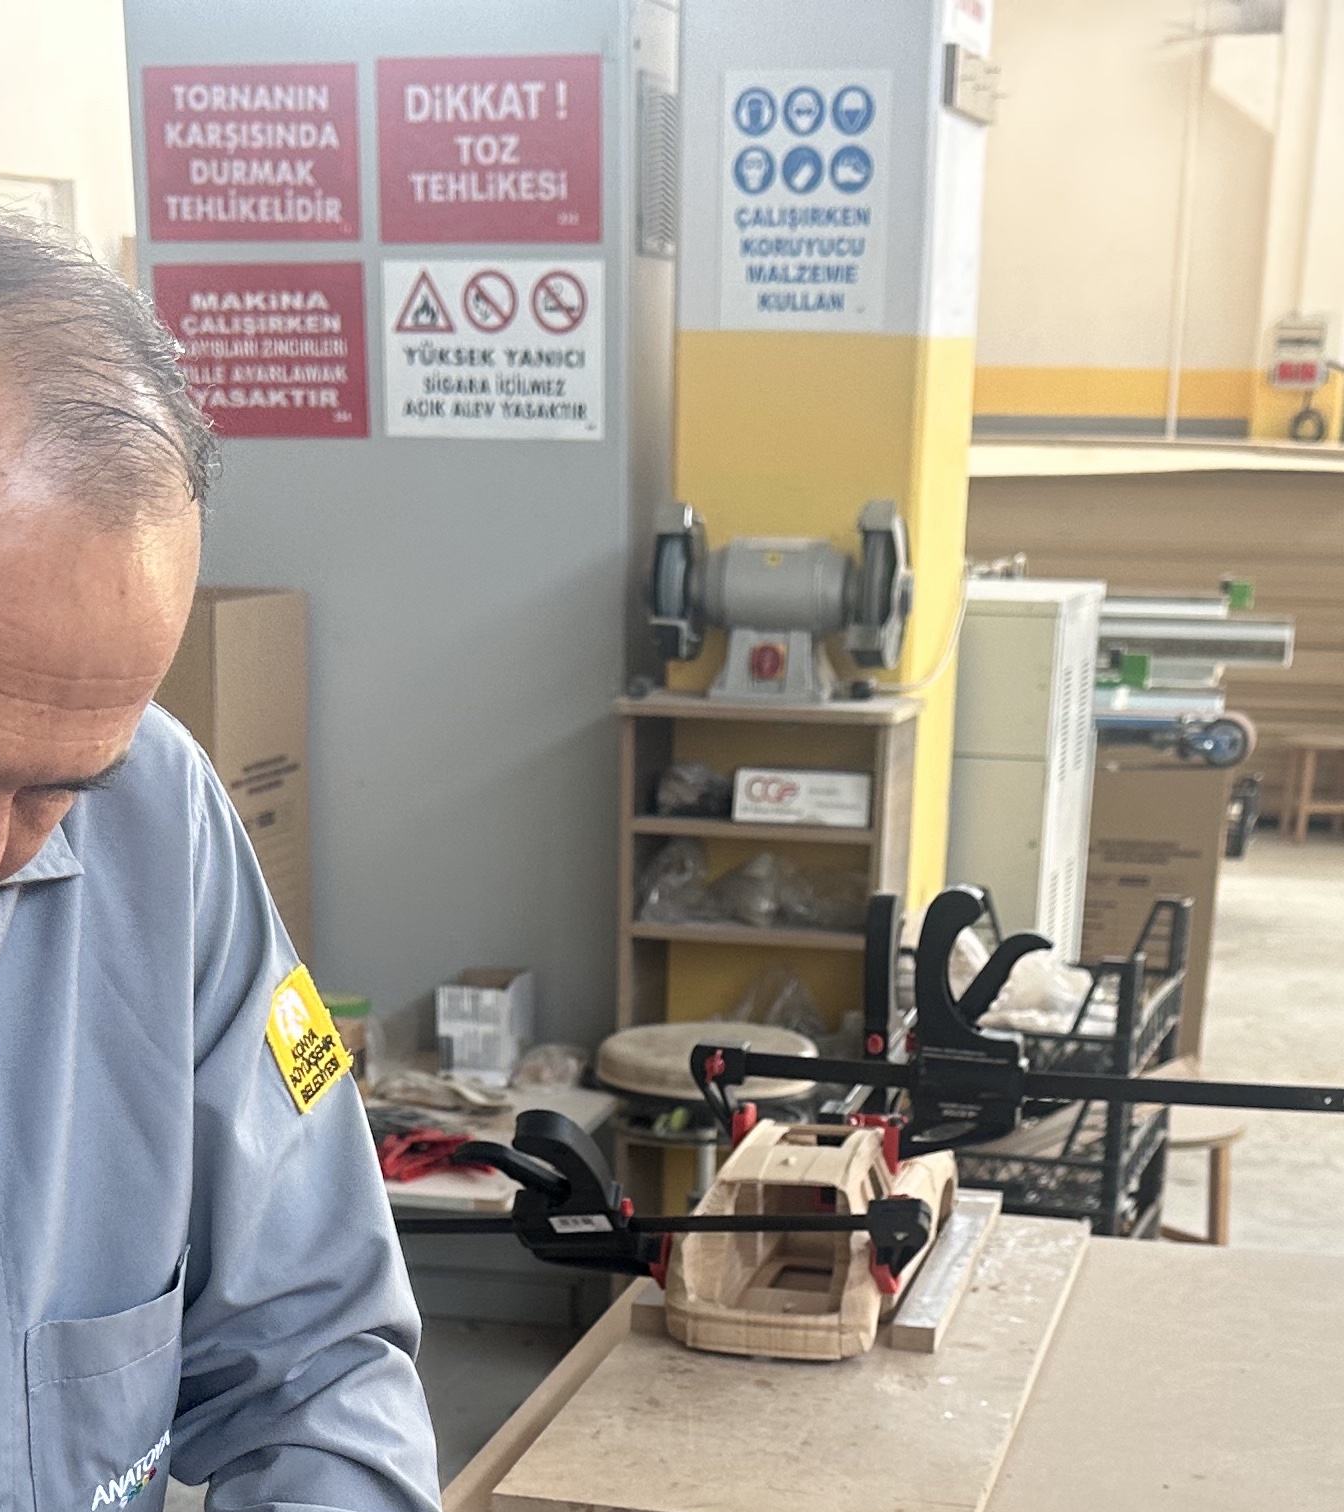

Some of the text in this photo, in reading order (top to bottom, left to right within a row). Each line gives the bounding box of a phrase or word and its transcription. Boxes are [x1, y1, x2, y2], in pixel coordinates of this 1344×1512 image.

[172, 83, 330, 112] TORNANIN
[164, 121, 341, 154] KARŞISINDA
[454, 133, 520, 166] TOZ
[189, 158, 316, 187] DURMAK
[165, 188, 344, 223] TEHLİKELİDİR
[734, 204, 872, 230] ÇALIŞIRKEN
[740, 236, 866, 257] KORUYUCU
[745, 264, 859, 284] MALZEME
[757, 291, 845, 312] KULLAN
[402, 340, 496, 367] YÜKSEK
[291, 1028, 319, 1062] KONYA
